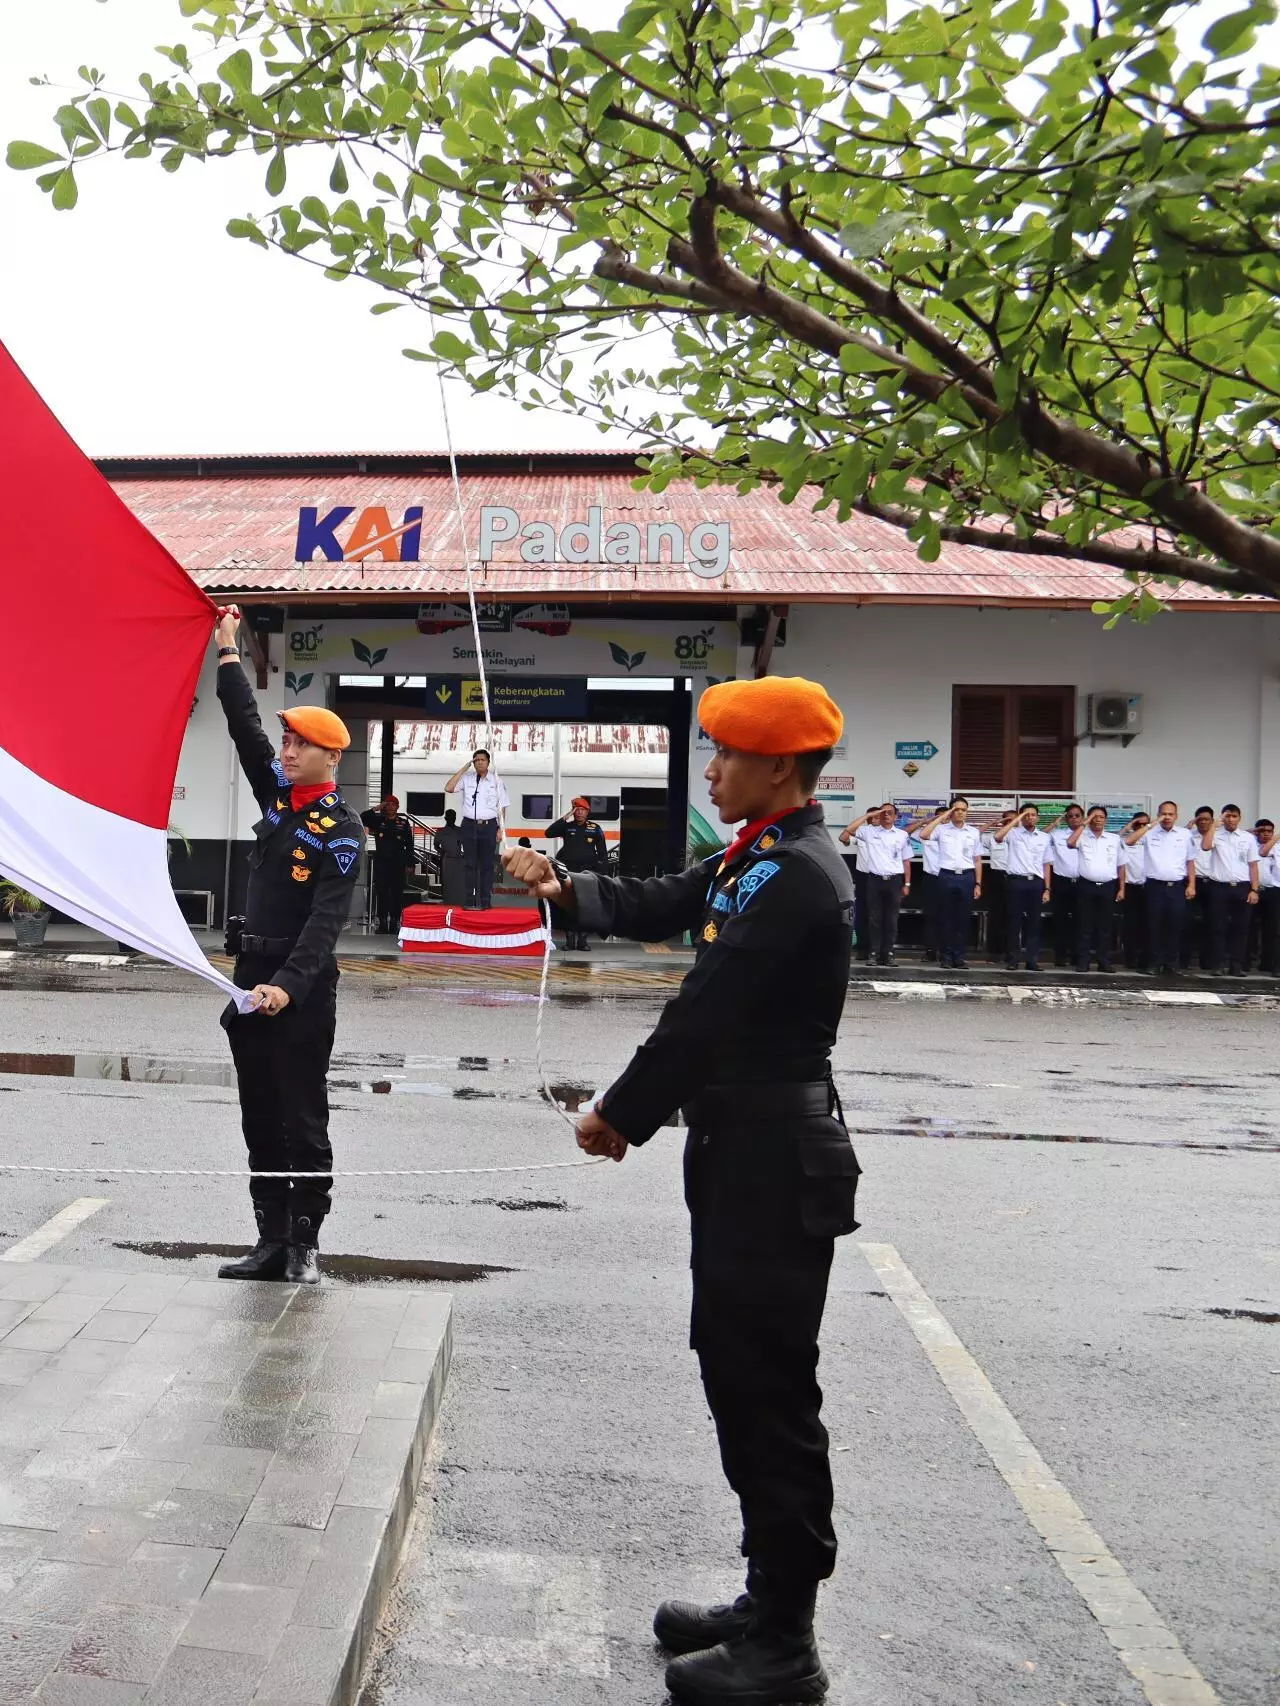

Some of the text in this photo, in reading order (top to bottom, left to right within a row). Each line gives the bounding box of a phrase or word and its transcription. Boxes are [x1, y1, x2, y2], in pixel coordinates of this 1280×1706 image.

[295, 506, 423, 562] KAI
[480, 506, 731, 579] Padang
[489, 655, 536, 668] Melayani
[494, 687, 565, 698] Keberangkatan
[493, 698, 531, 706] Departures
[295, 828, 323, 850] POLSUSKA
[740, 876, 758, 892] SB
